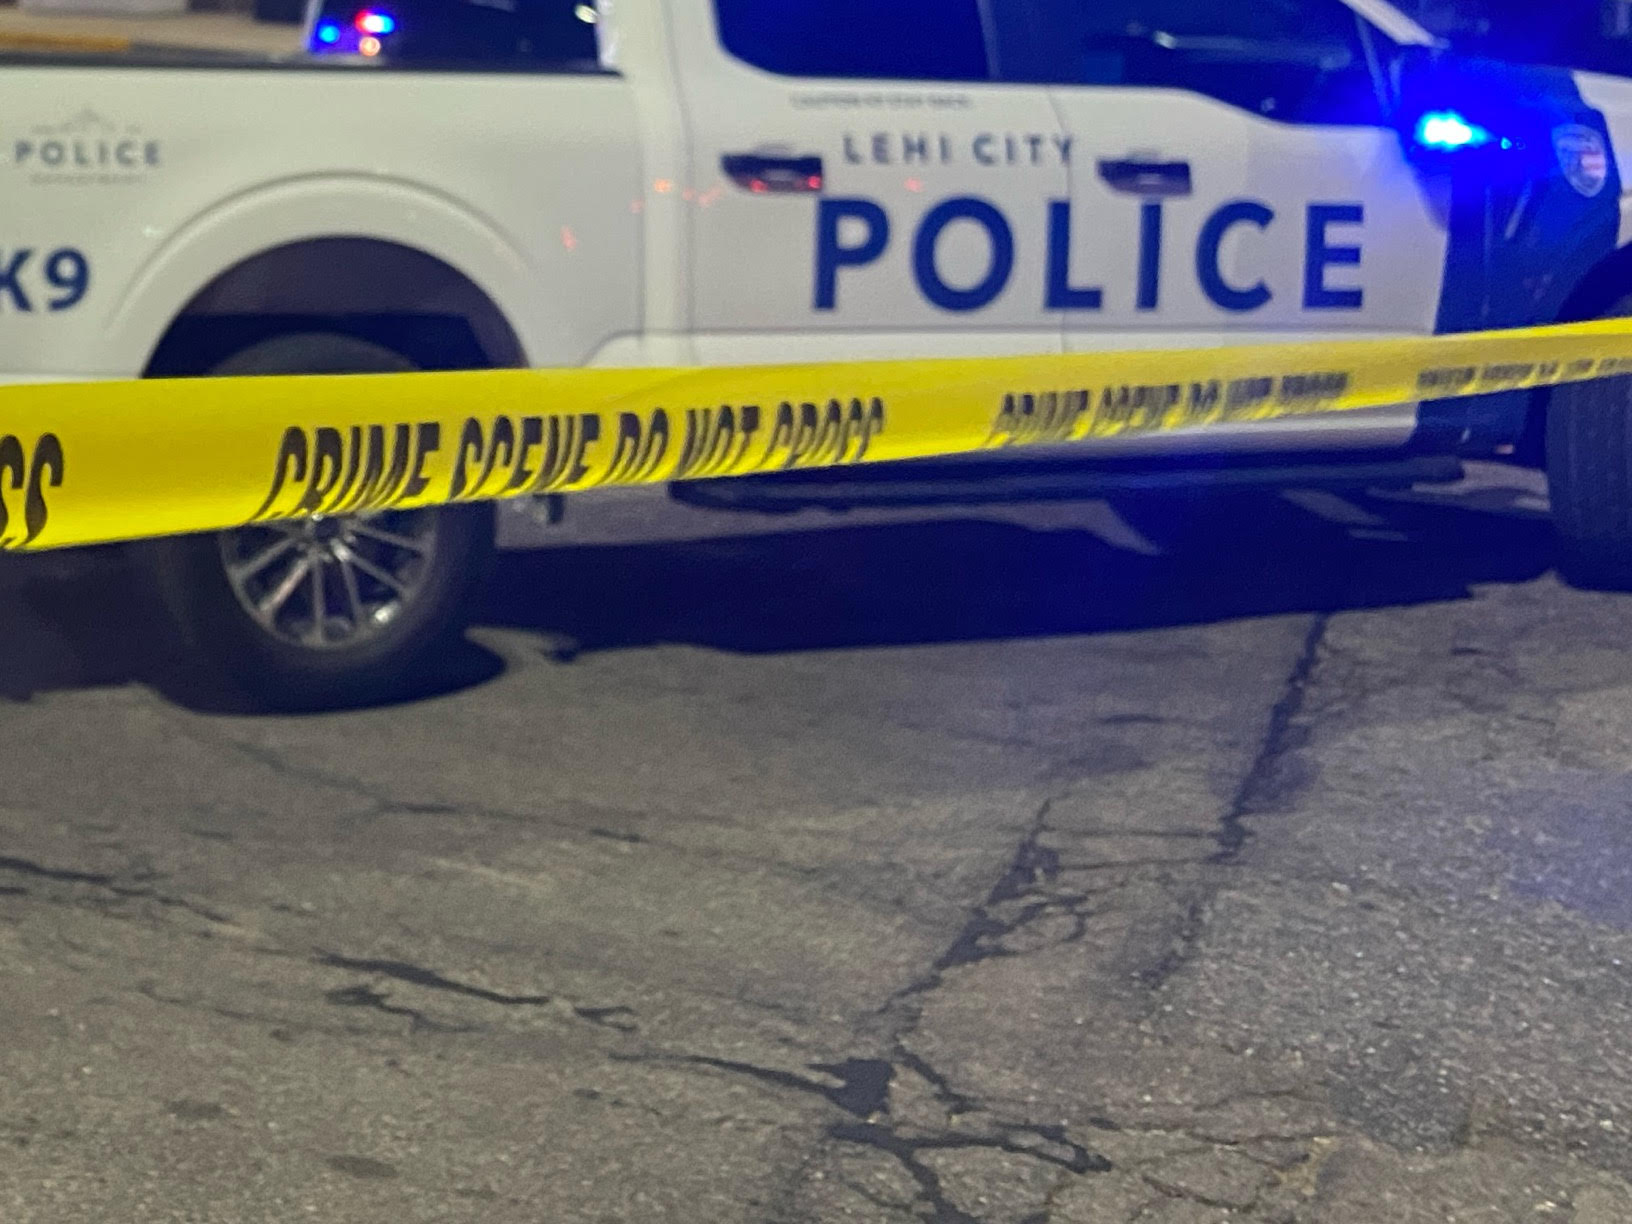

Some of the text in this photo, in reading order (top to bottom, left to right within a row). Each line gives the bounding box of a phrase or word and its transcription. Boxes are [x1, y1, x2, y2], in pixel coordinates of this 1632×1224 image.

[13, 140, 162, 166] POLICE
[841, 132, 1073, 165] LEHI CITY
[811, 196, 1365, 312] POLICE
